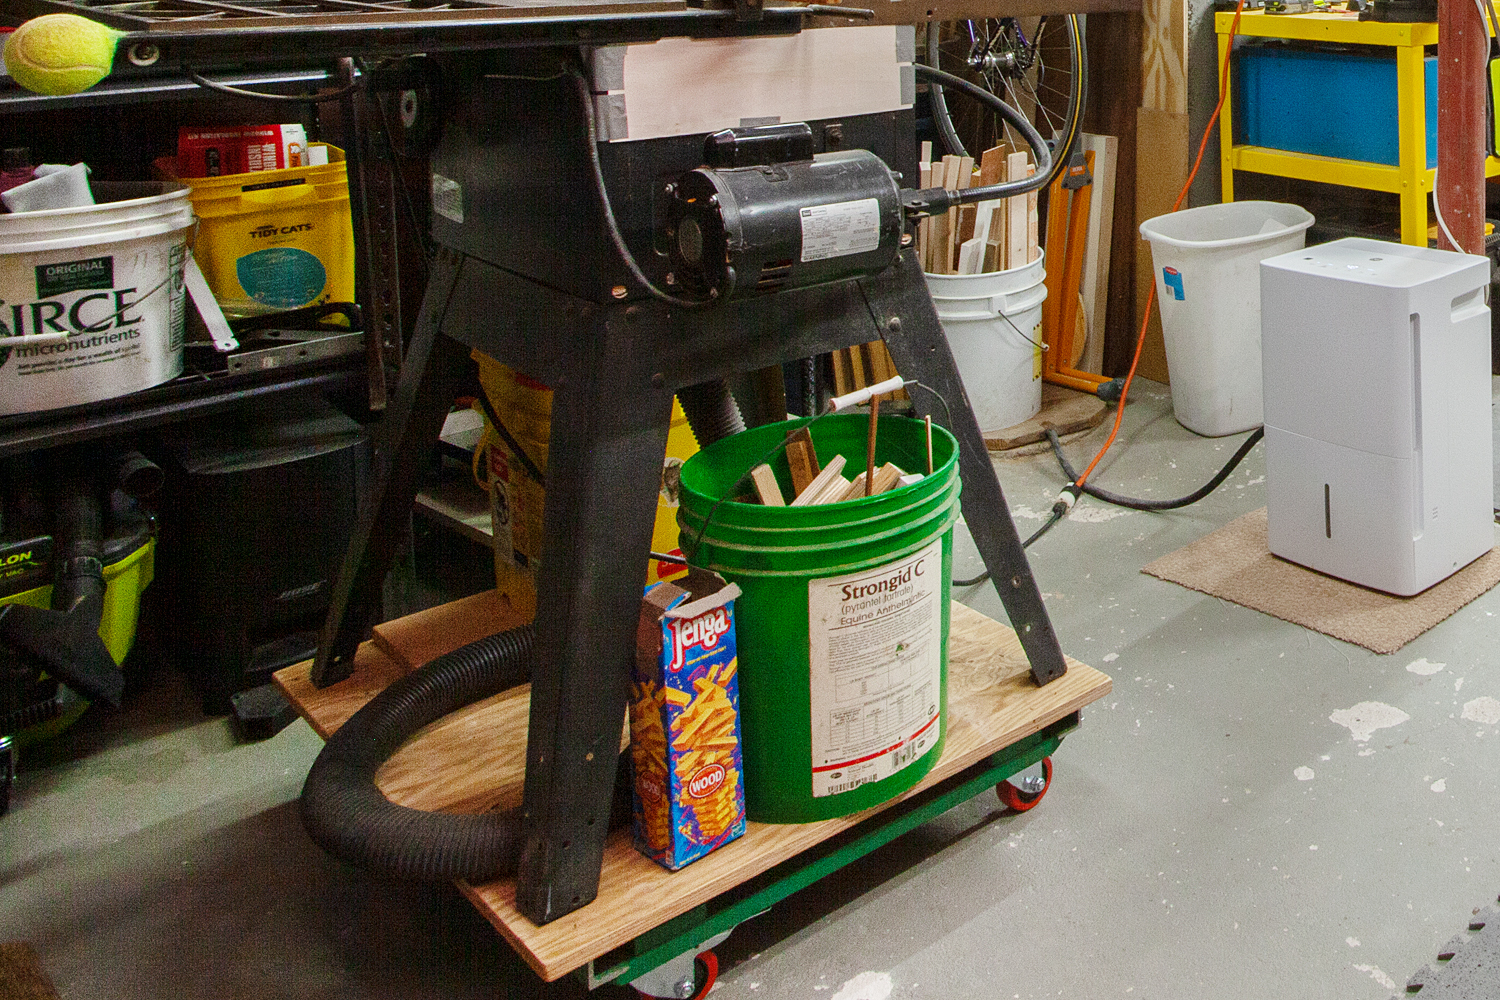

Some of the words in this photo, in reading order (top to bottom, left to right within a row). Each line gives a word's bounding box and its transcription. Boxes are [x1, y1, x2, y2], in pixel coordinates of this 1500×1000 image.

[248, 228, 279, 240] TIDY
[280, 222, 314, 235] CATS
[46, 260, 105, 277] ORIGINAL
[15, 326, 141, 359] micronutrients
[841, 565, 912, 602] Strongid
[914, 559, 925, 577] C
[840, 611, 874, 626] Equine
[876, 589, 926, 617] Anthelmintic
[841, 597, 881, 616] (pyrantel
[884, 584, 914, 603] tartrate)
[672, 609, 729, 670] Jenga
[691, 770, 723, 794] WOOD
